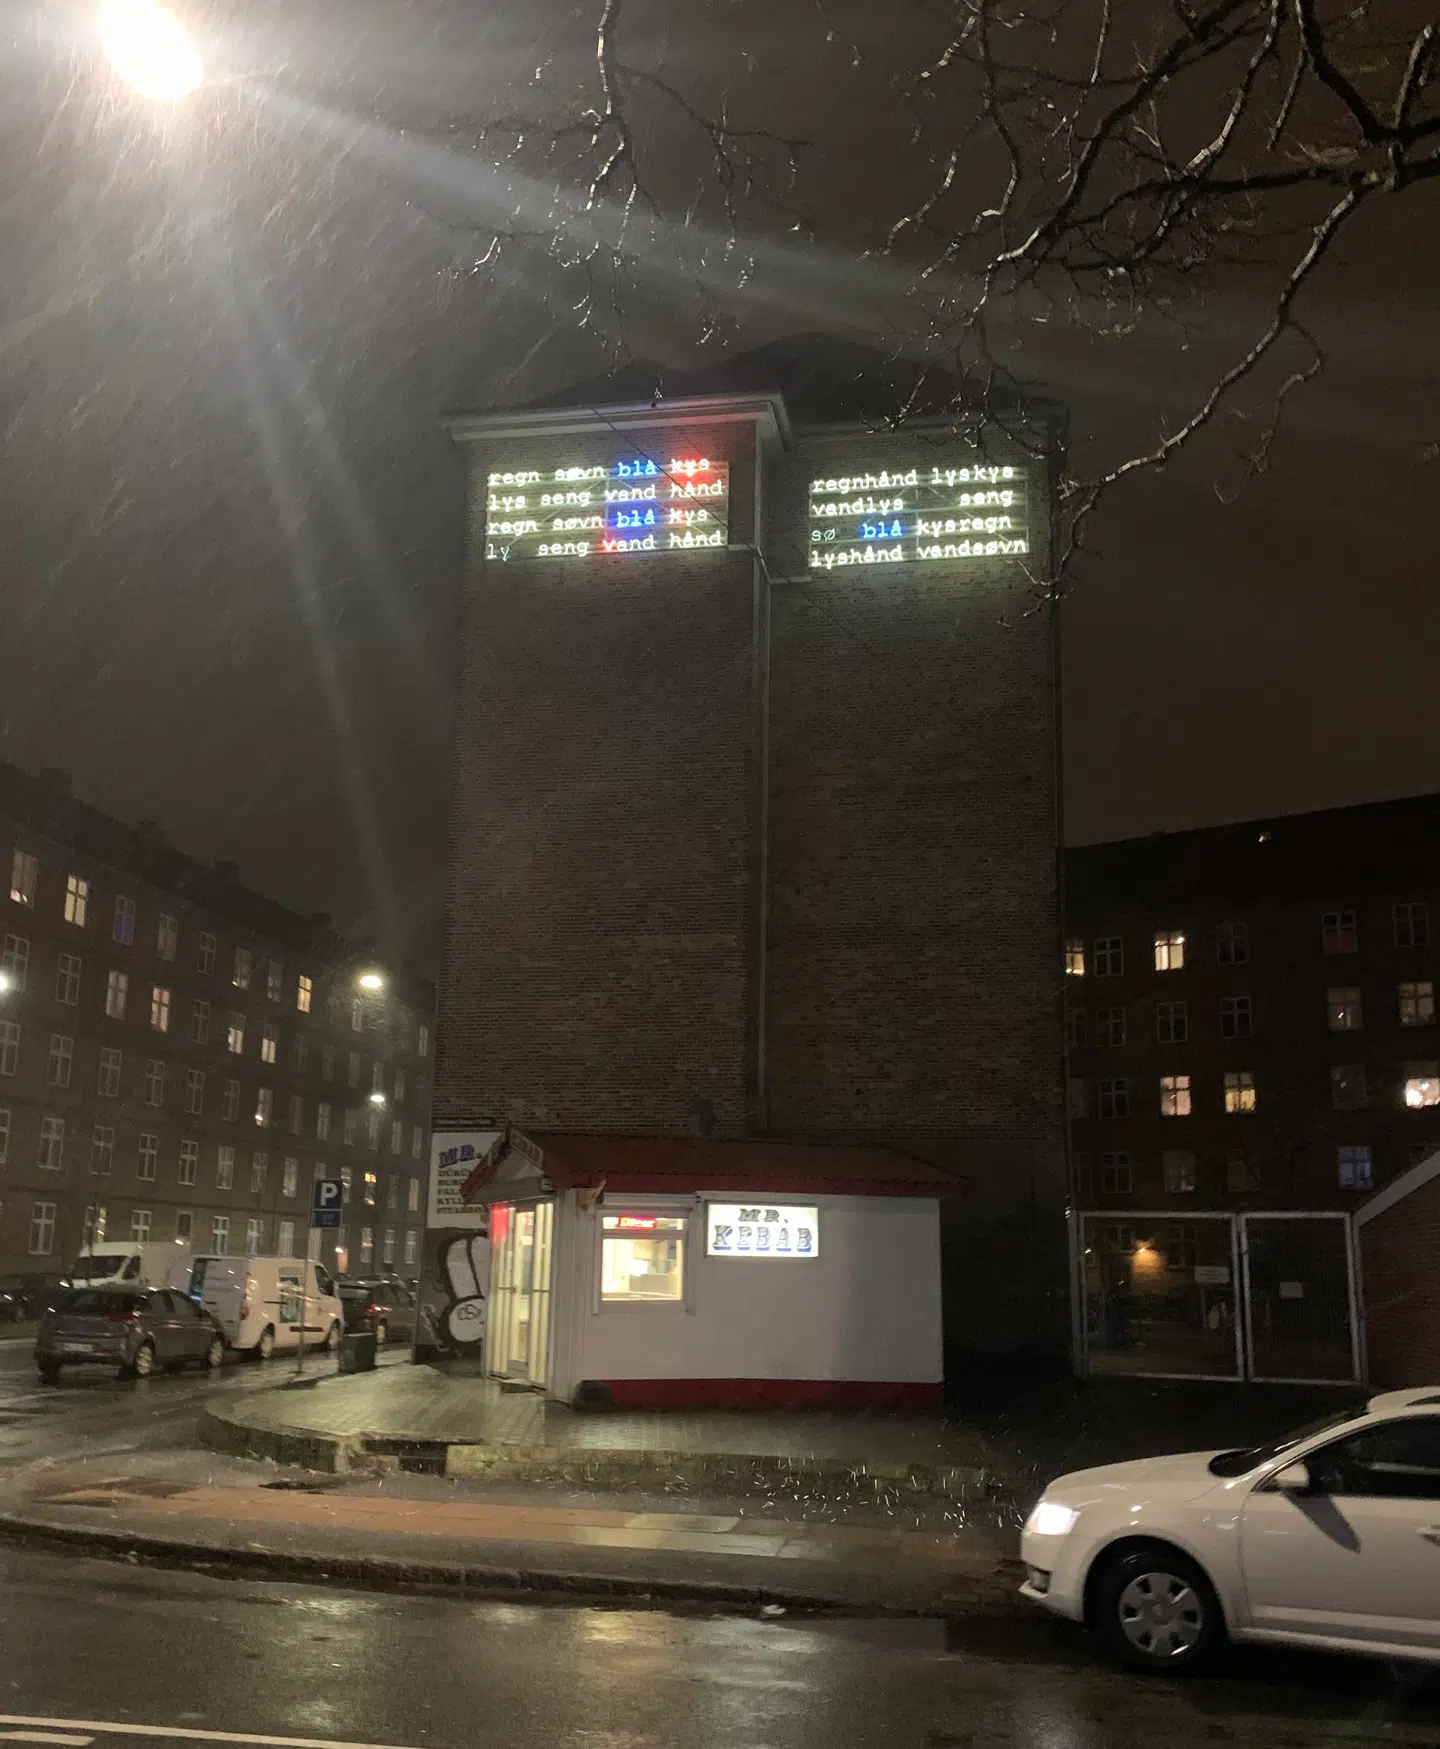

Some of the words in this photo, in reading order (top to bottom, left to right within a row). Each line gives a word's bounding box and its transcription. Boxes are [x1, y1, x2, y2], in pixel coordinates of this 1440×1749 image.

[488, 470, 540, 487] regn
[554, 466, 606, 481] søvn
[618, 459, 657, 477] blå
[671, 458, 710, 477] kys
[812, 470, 917, 494] regnhånd
[931, 464, 1014, 486] lyskys
[489, 494, 526, 513] lys
[540, 490, 591, 507] seng
[604, 484, 656, 501] vand
[670, 480, 723, 498] hånd
[811, 496, 904, 516] vandlys
[959, 489, 1013, 508] seng
[487, 520, 537, 537] regn
[552, 515, 604, 531] søvn
[616, 509, 656, 528] blå
[669, 508, 708, 526] kys
[862, 520, 902, 538] blå
[917, 515, 1012, 537] kysregn
[538, 541, 590, 557] seng
[603, 535, 656, 551] vand
[669, 531, 721, 548] hånd
[811, 545, 904, 569] lyshånd
[917, 539, 1027, 559] vandsøvn
[320, 1182, 338, 1206] P
[738, 1208, 789, 1223] MR.
[712, 1224, 813, 1253] KEBAB
